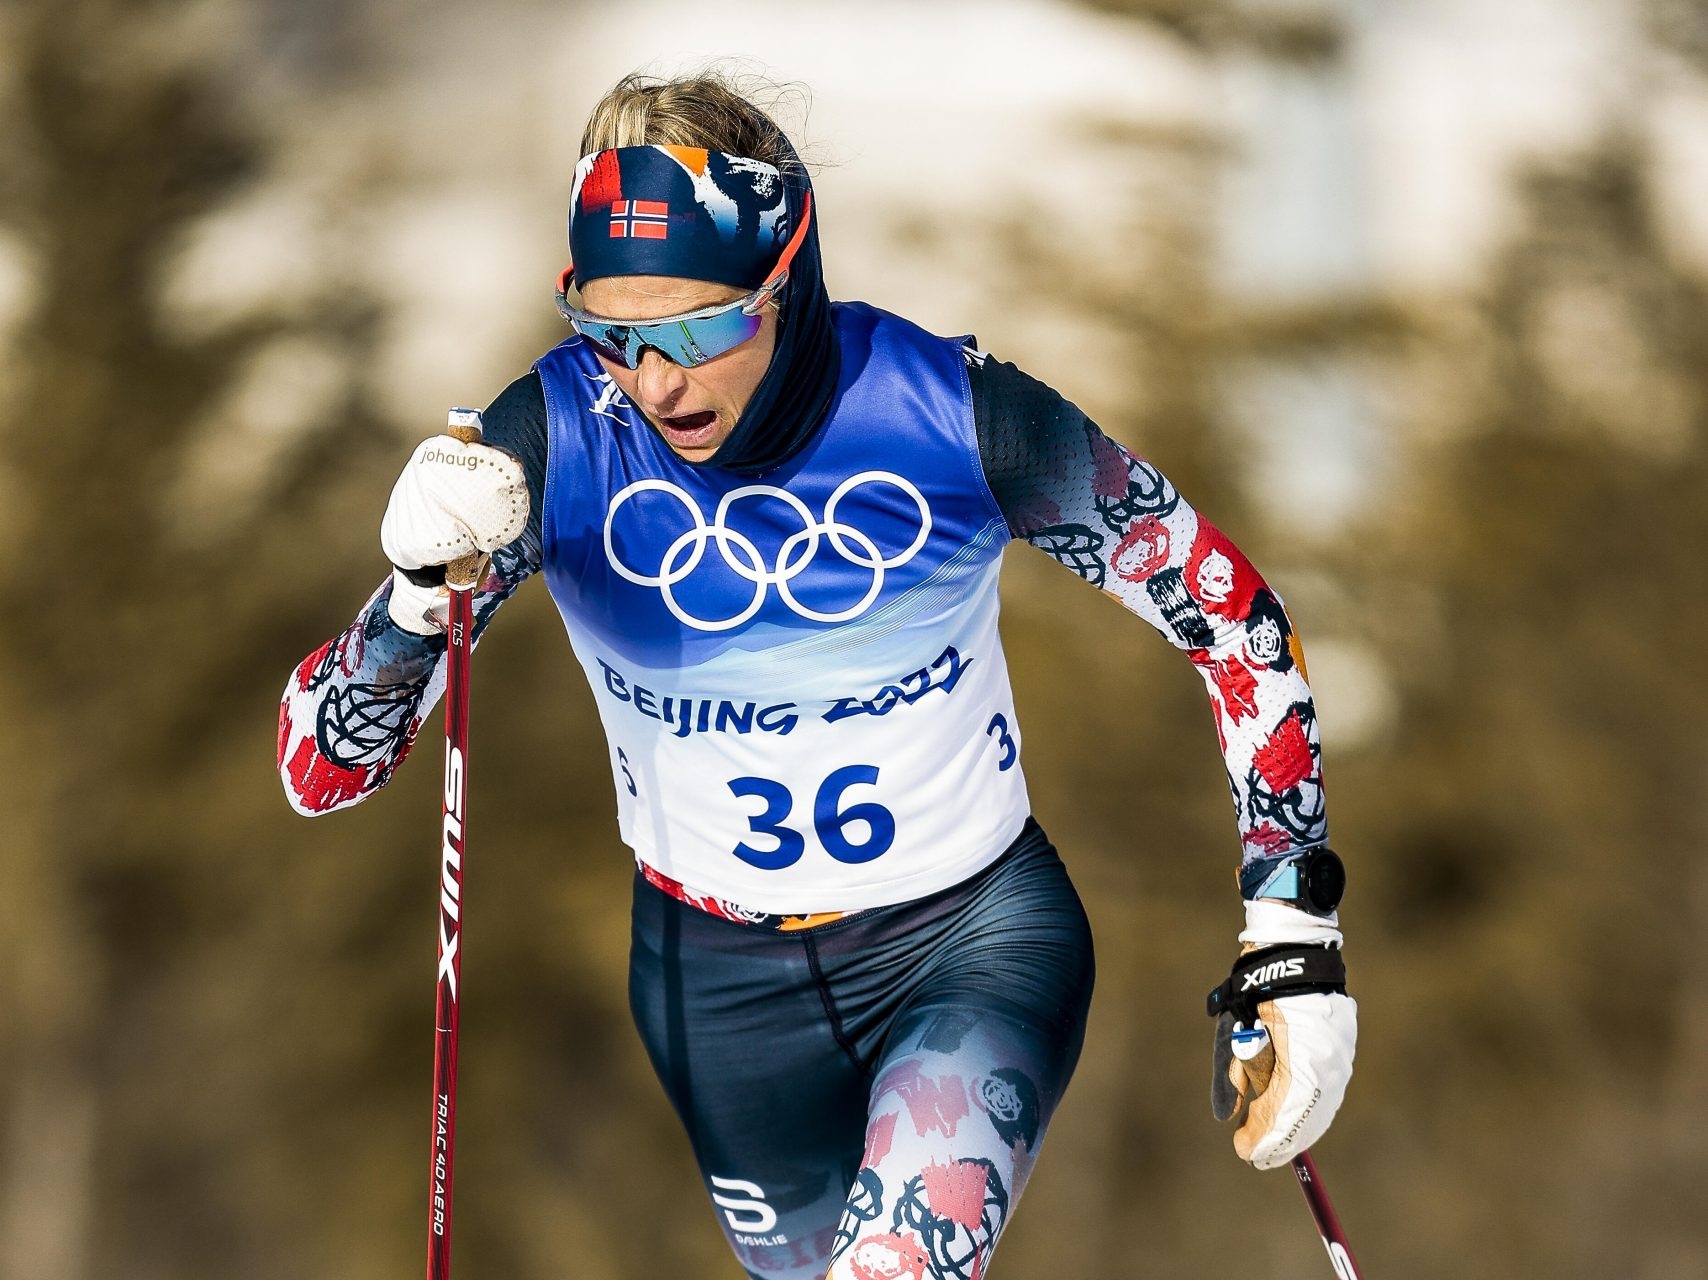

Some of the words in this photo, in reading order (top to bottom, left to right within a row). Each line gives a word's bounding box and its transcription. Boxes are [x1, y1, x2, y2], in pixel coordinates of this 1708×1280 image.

[420, 447, 478, 471] johaug
[596, 657, 798, 737] BEIJING
[821, 645, 974, 723] 2022
[727, 765, 895, 870] 36
[438, 735, 463, 1004] SWIX
[1241, 958, 1305, 991] SWIX
[436, 1094, 448, 1150] TRIAC
[1284, 1087, 1321, 1143] johaug
[433, 1181, 444, 1235] AERO
